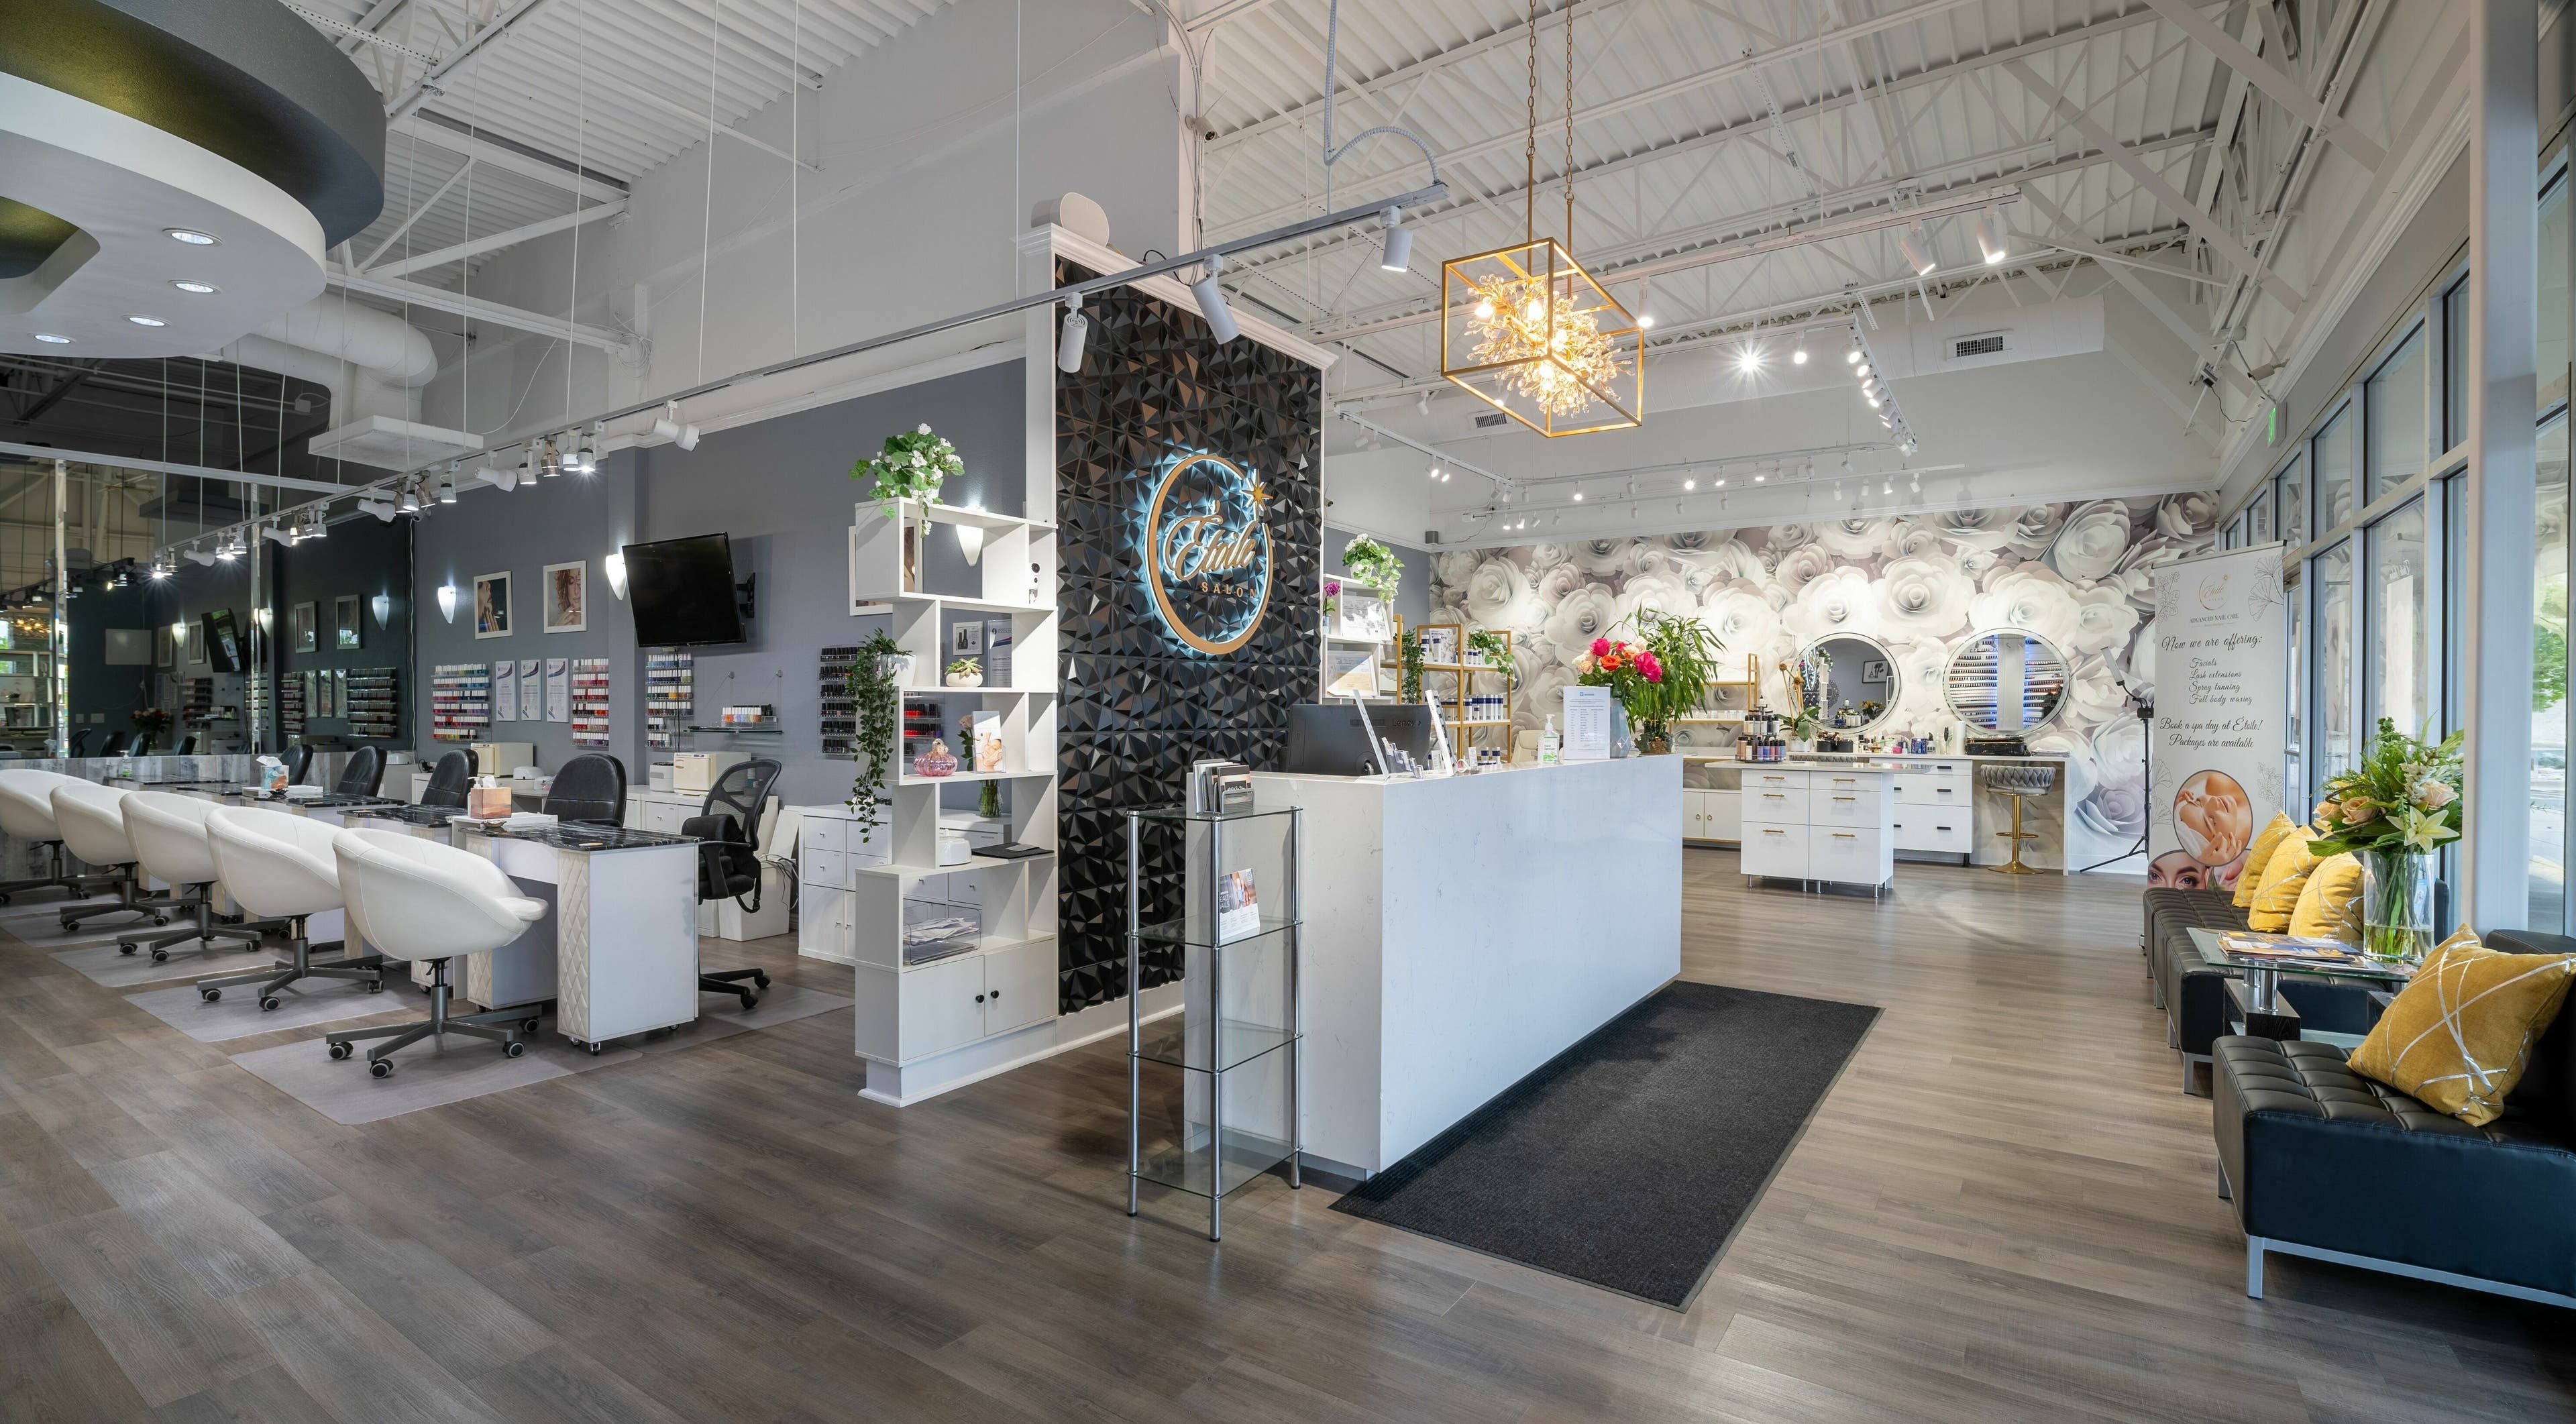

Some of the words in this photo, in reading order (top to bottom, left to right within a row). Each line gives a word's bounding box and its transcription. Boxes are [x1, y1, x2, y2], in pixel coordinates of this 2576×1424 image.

[1201, 581, 1258, 598] SALON
[2161, 636, 2186, 651] Now
[2189, 640, 2202, 648] we
[2205, 638, 2220, 647] are
[2224, 633, 2263, 651] offering:
[2190, 657, 2217, 669] Facials
[2189, 669, 2206, 681] Lash
[2208, 670, 2242, 679] extensions
[2188, 680, 2212, 694] Spray
[2214, 682, 2241, 693] tanning
[2189, 694, 2208, 704] Full
[2210, 694, 2226, 706] body
[2230, 696, 2253, 706] waxing
[2159, 717, 2183, 730] Book
[2191, 722, 2203, 733] spa
[2205, 719, 2219, 734] day
[2221, 720, 2231, 730] at
[2233, 716, 2263, 732] Étoile!
[2169, 733, 2206, 751] Packages
[2208, 738, 2220, 747] are
[2221, 737, 2254, 748] available
